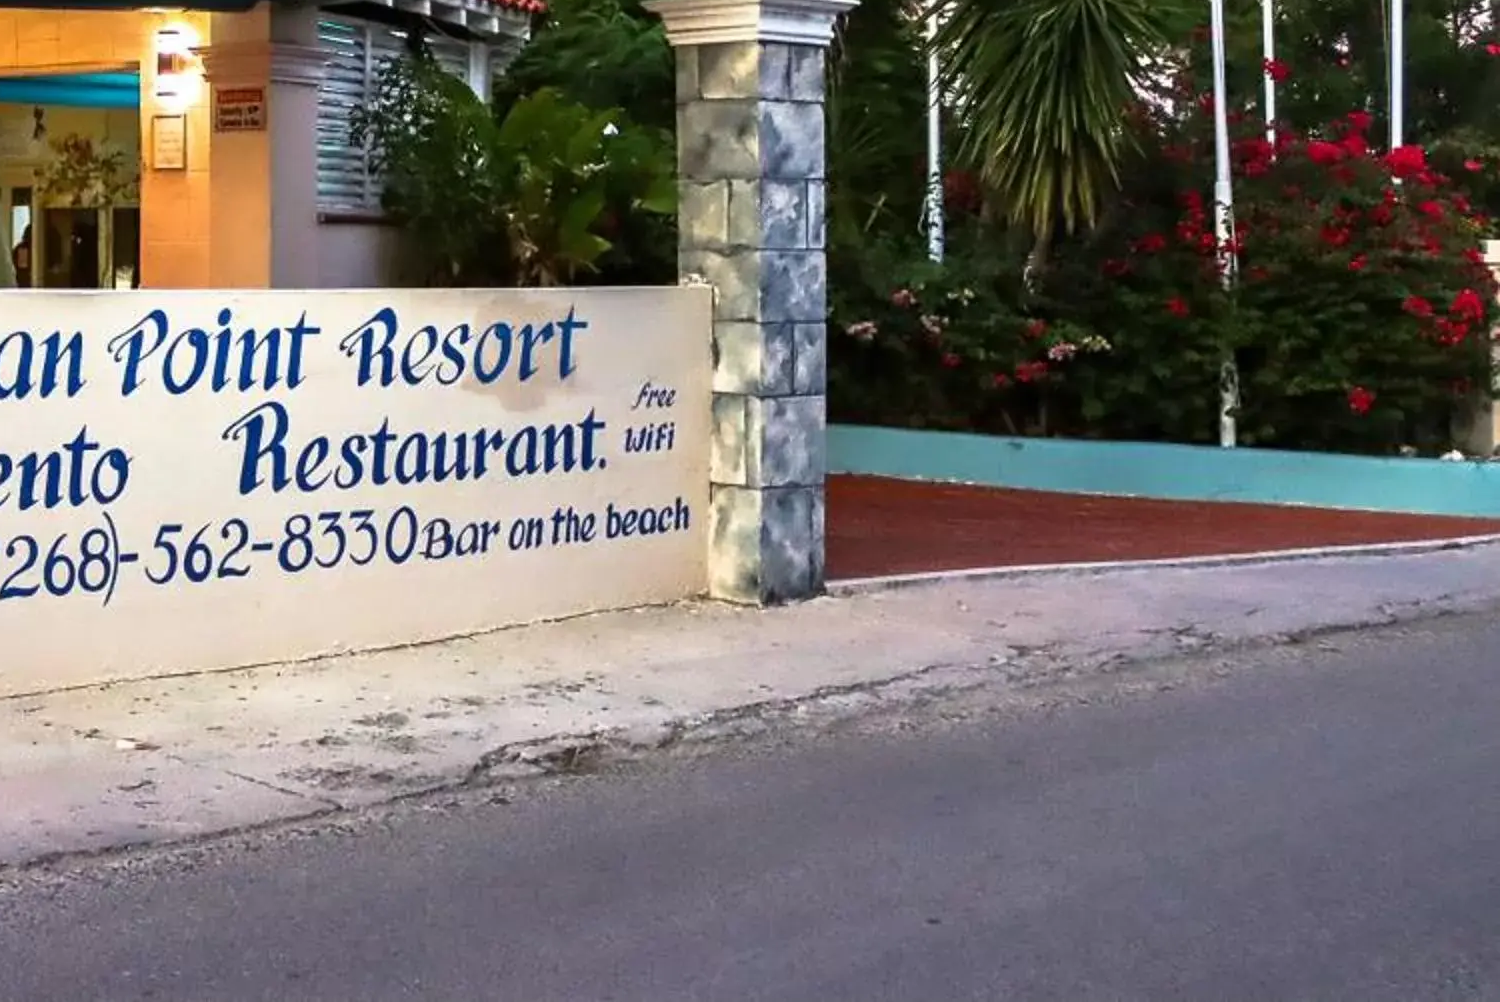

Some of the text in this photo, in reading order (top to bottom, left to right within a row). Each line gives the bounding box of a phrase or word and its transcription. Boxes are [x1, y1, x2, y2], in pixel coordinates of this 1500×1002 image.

[107, 308, 322, 396] Point
[339, 305, 589, 389] Resort
[630, 380, 677, 411] free
[221, 401, 607, 496] Restaurant.
[420, 517, 499, 559] Bar
[509, 517, 544, 550] on
[550, 505, 597, 545] the
[605, 496, 690, 540] beach
